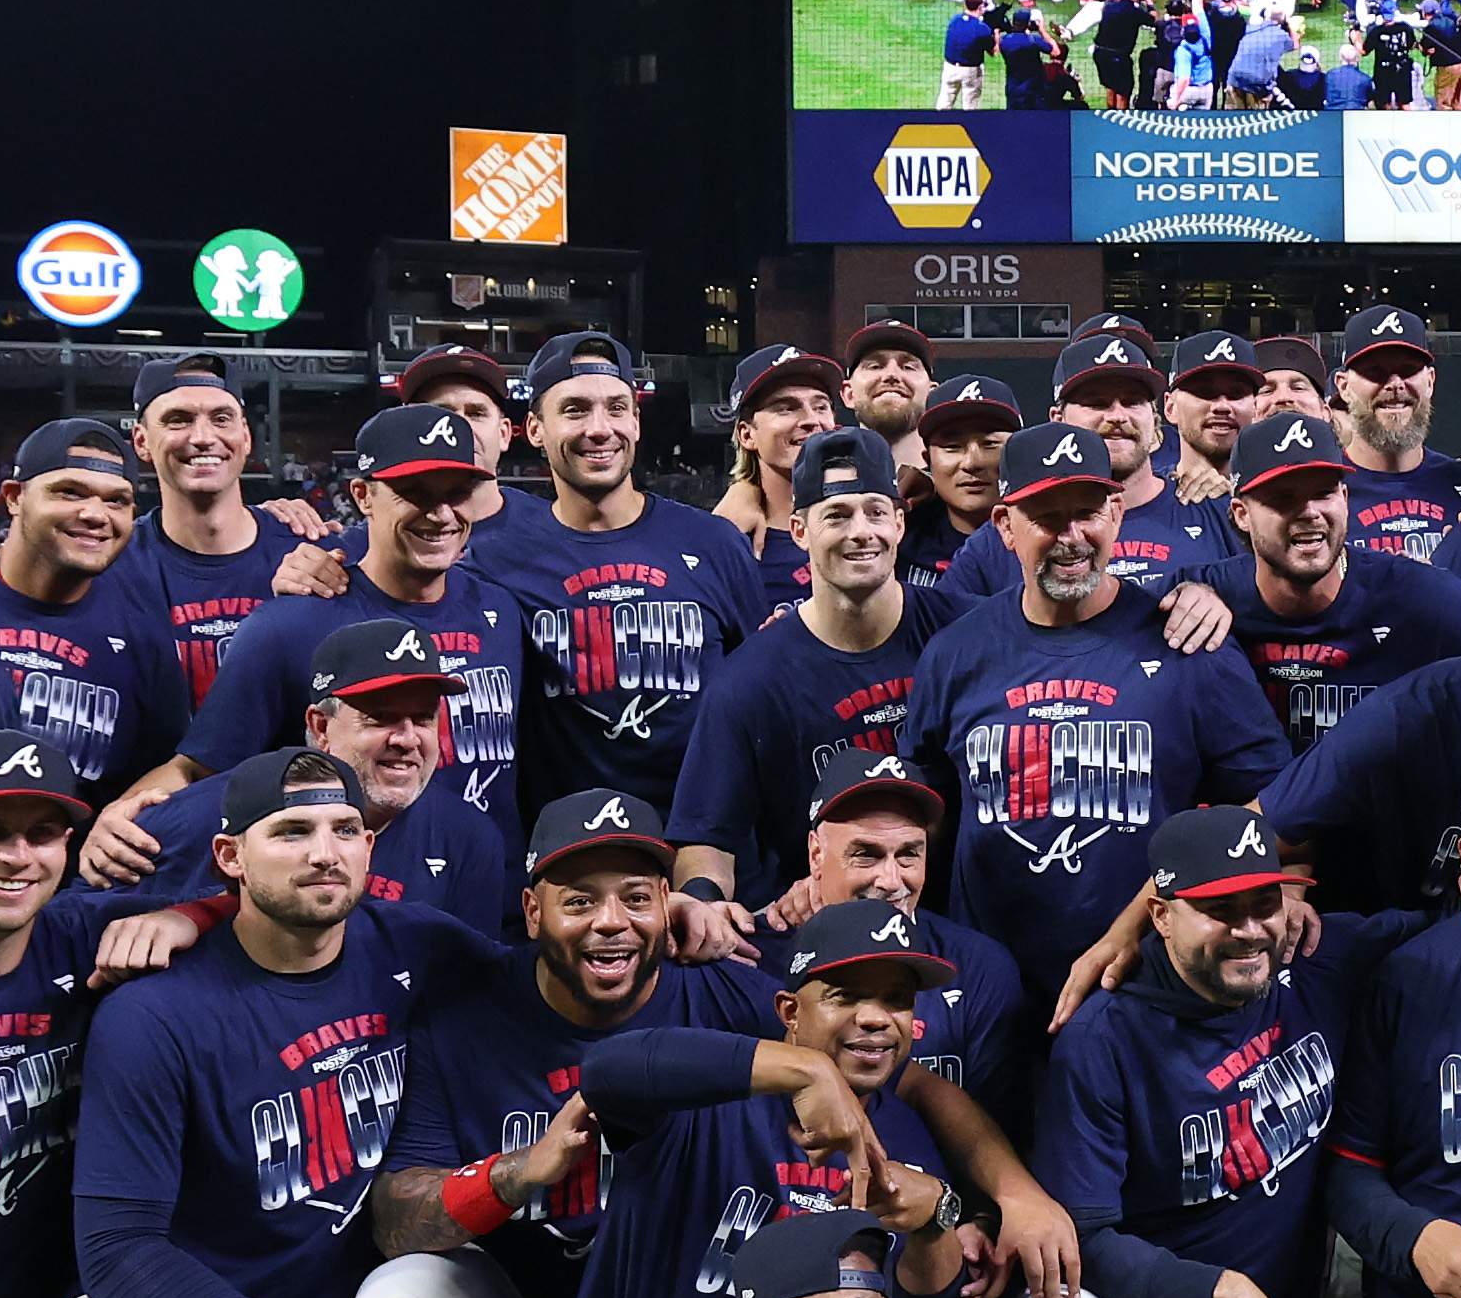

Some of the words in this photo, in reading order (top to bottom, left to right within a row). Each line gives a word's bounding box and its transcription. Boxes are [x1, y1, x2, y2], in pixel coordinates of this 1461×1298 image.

[462, 142, 513, 186] THE
[895, 155, 972, 198] NAPA
[1094, 151, 1320, 178] NORTHSIDE
[453, 134, 565, 239] HOME
[1136, 183, 1279, 202] HOSPITAL
[496, 174, 565, 241] DEPOT
[30, 254, 128, 289] Gulf
[913, 253, 1020, 285] ORIS
[988, 289, 1019, 298] 1904
[1357, 499, 1445, 526] BRAVES
[562, 563, 668, 596] BRAVES
[588, 582, 646, 601] POSTSEASON
[0, 648, 63, 671] POSTSEASON
[531, 600, 704, 698] CLINCHED
[834, 677, 914, 717] BRAV
[1005, 679, 1119, 710] BRAVES
[1028, 701, 1089, 719] POSTSEASON
[863, 703, 908, 726] POSTSEAS
[966, 720, 1153, 825] CLINCHED
[279, 1012, 388, 1072] BRAVES
[250, 1043, 407, 1211] CLINCH
[775, 1161, 853, 1188] BRAV
